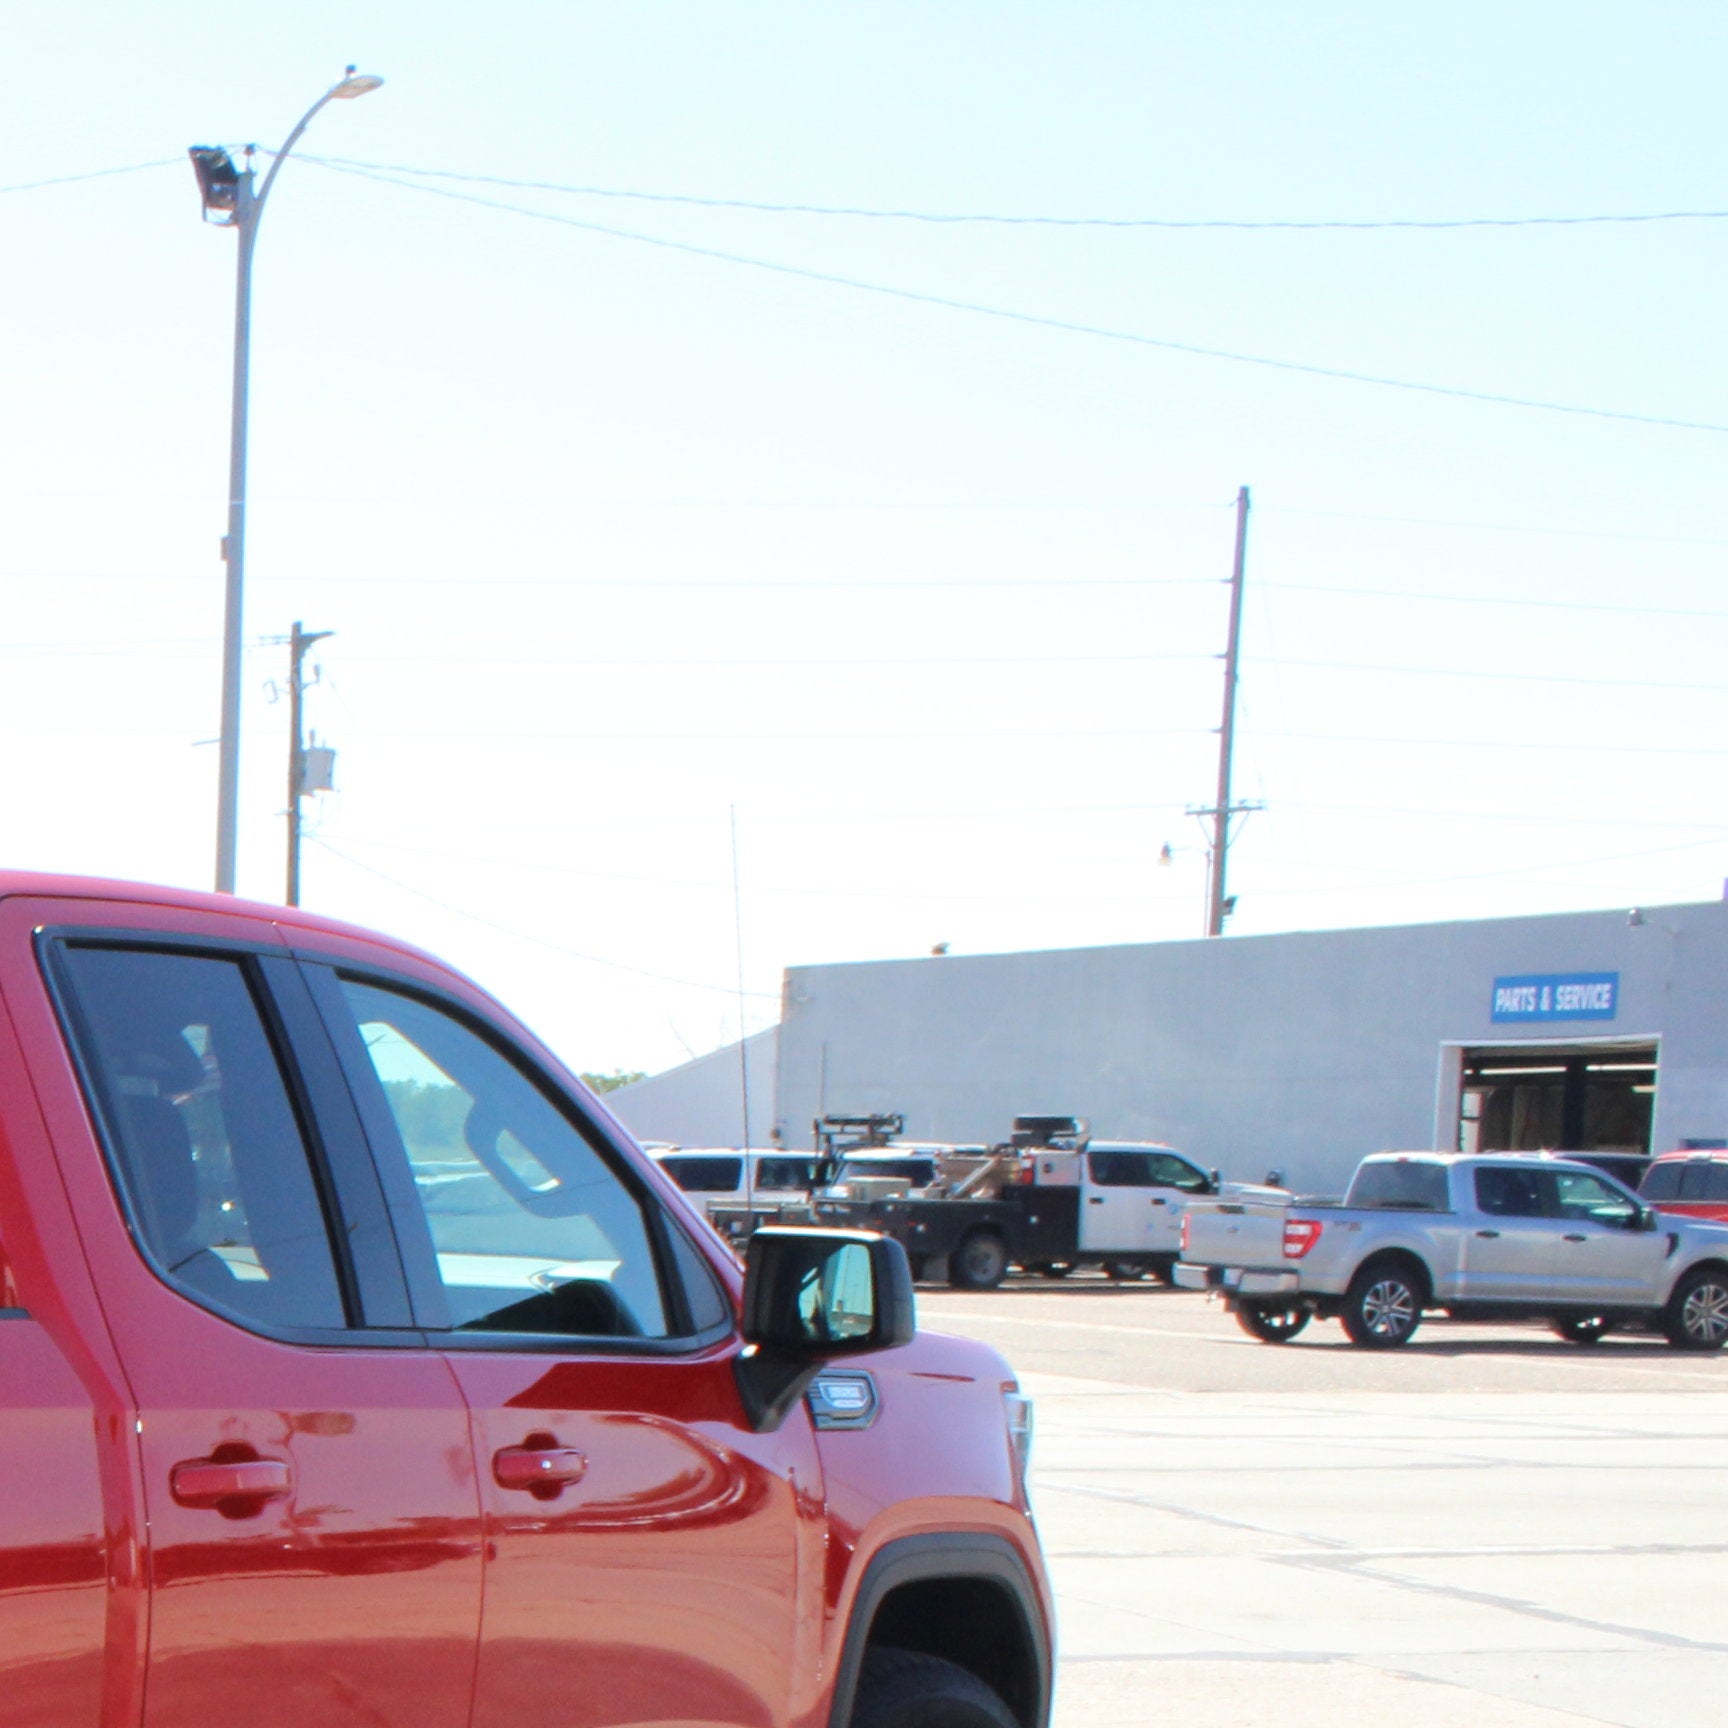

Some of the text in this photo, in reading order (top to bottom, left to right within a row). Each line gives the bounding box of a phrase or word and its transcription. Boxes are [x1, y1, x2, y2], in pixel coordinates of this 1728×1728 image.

[1495, 983, 1612, 1012] PARTS & SERVICE
